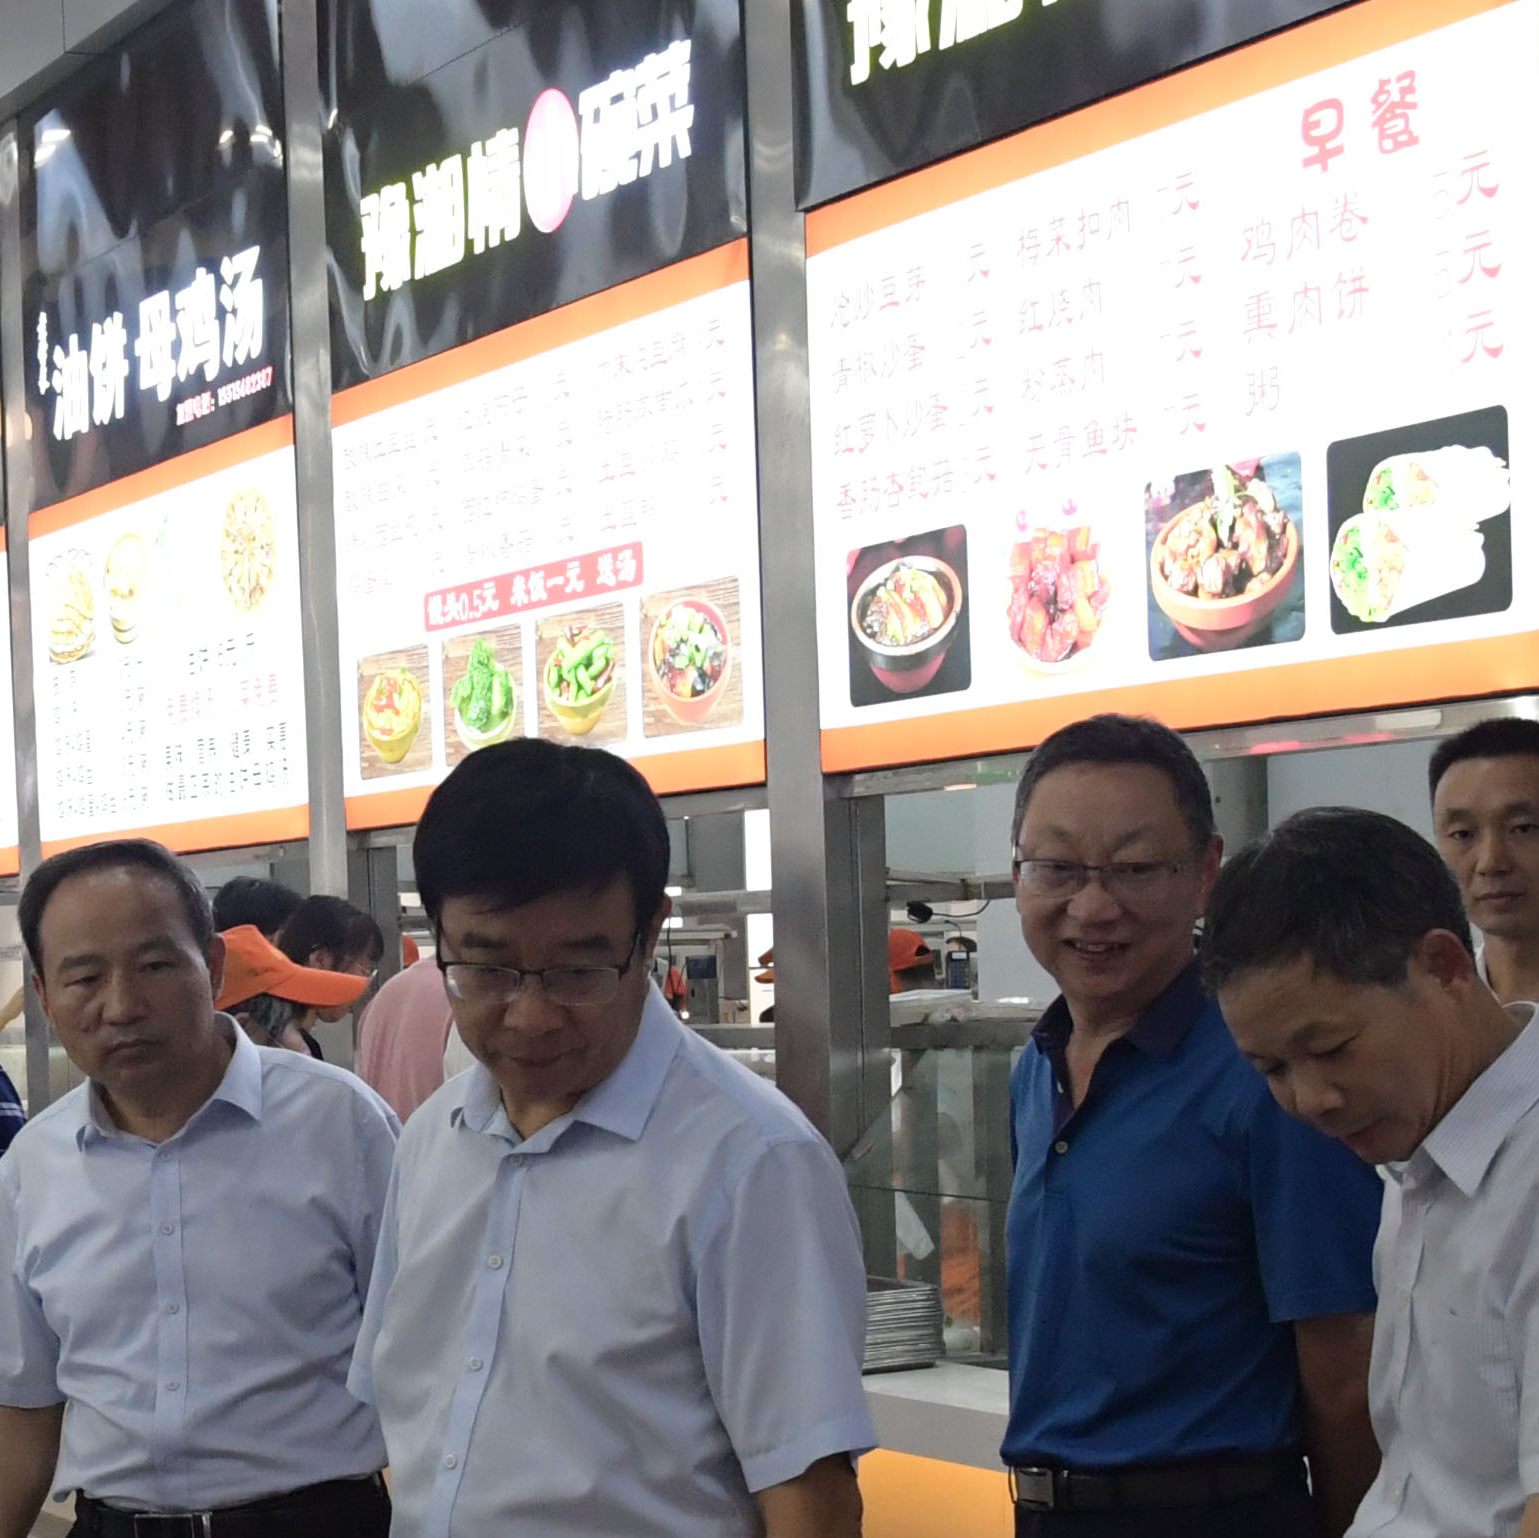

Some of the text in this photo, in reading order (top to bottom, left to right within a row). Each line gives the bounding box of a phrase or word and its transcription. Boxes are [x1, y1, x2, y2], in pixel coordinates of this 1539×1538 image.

[1300, 70, 1420, 174] 早餐
[1016, 194, 1132, 267] 梅菜扣肉
[1240, 193, 1370, 266] 鸡肉卷
[1017, 276, 1104, 337] 红烧肉
[1244, 365, 1281, 418] 粥
